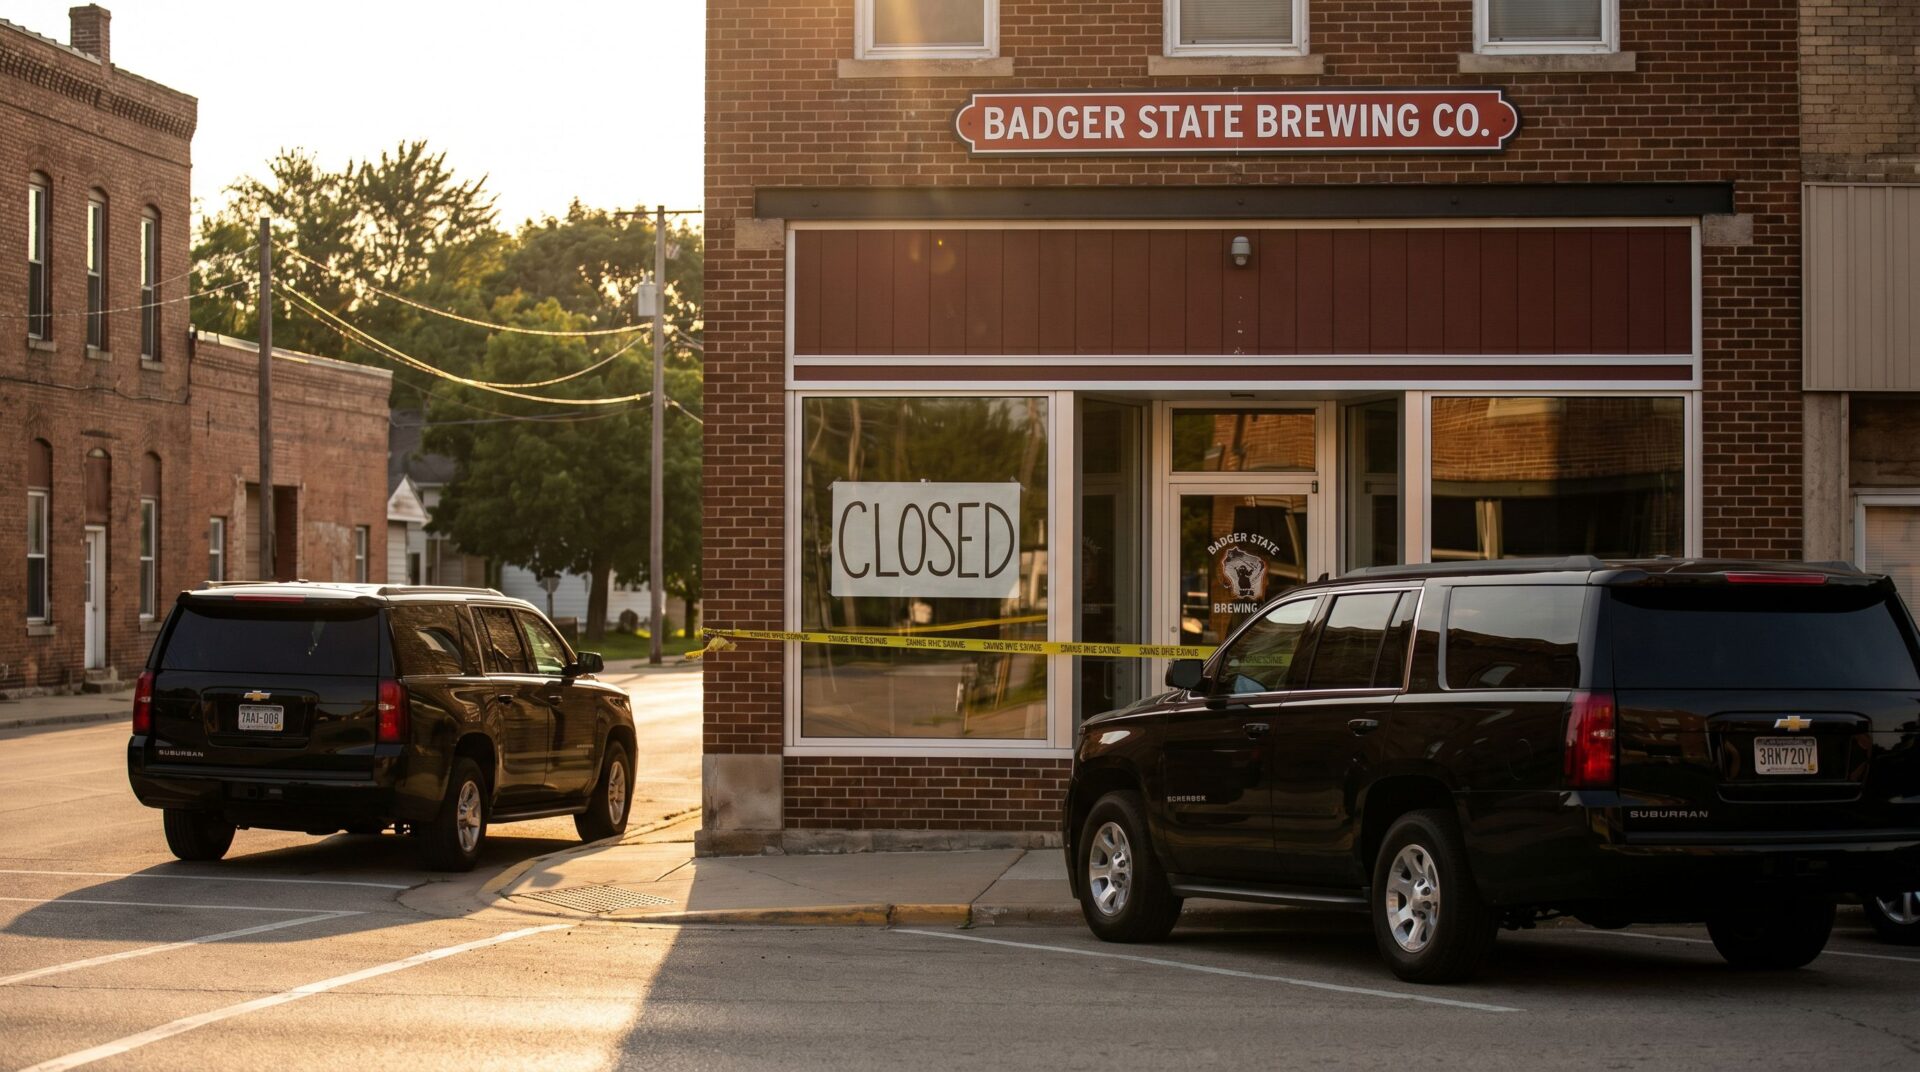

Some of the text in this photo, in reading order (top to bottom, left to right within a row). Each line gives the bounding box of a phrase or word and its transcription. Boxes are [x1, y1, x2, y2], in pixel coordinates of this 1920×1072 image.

[984, 103, 1490, 140] BADGER STATE BREWING CO.
[838, 501, 1015, 579] CLOSED
[1207, 532, 1280, 556] BADGER STATE
[1213, 603, 1258, 614] BREWING
